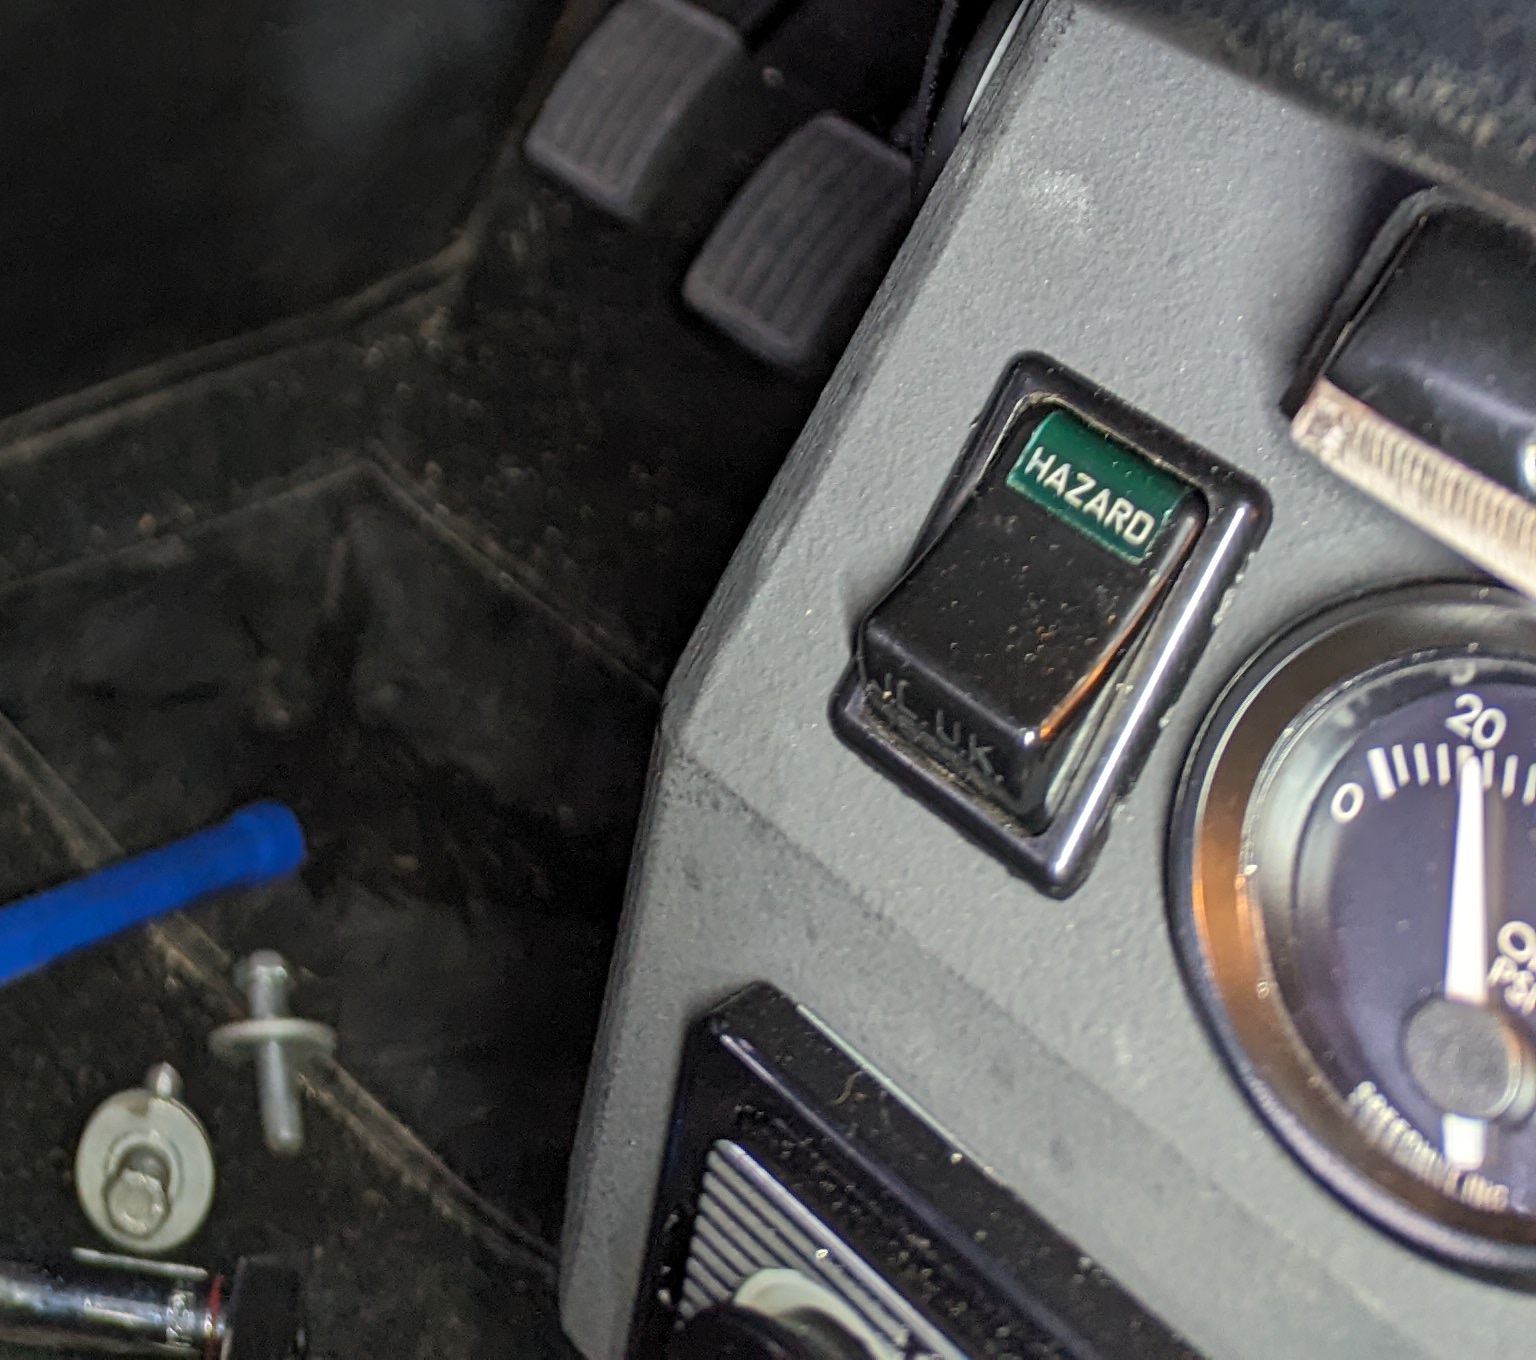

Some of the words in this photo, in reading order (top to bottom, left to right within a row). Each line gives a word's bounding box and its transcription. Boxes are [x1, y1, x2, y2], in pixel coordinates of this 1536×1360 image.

[1024, 446, 1156, 546] HAZARD
[1445, 692, 1508, 751] 20
[1330, 782, 1365, 824] 0
